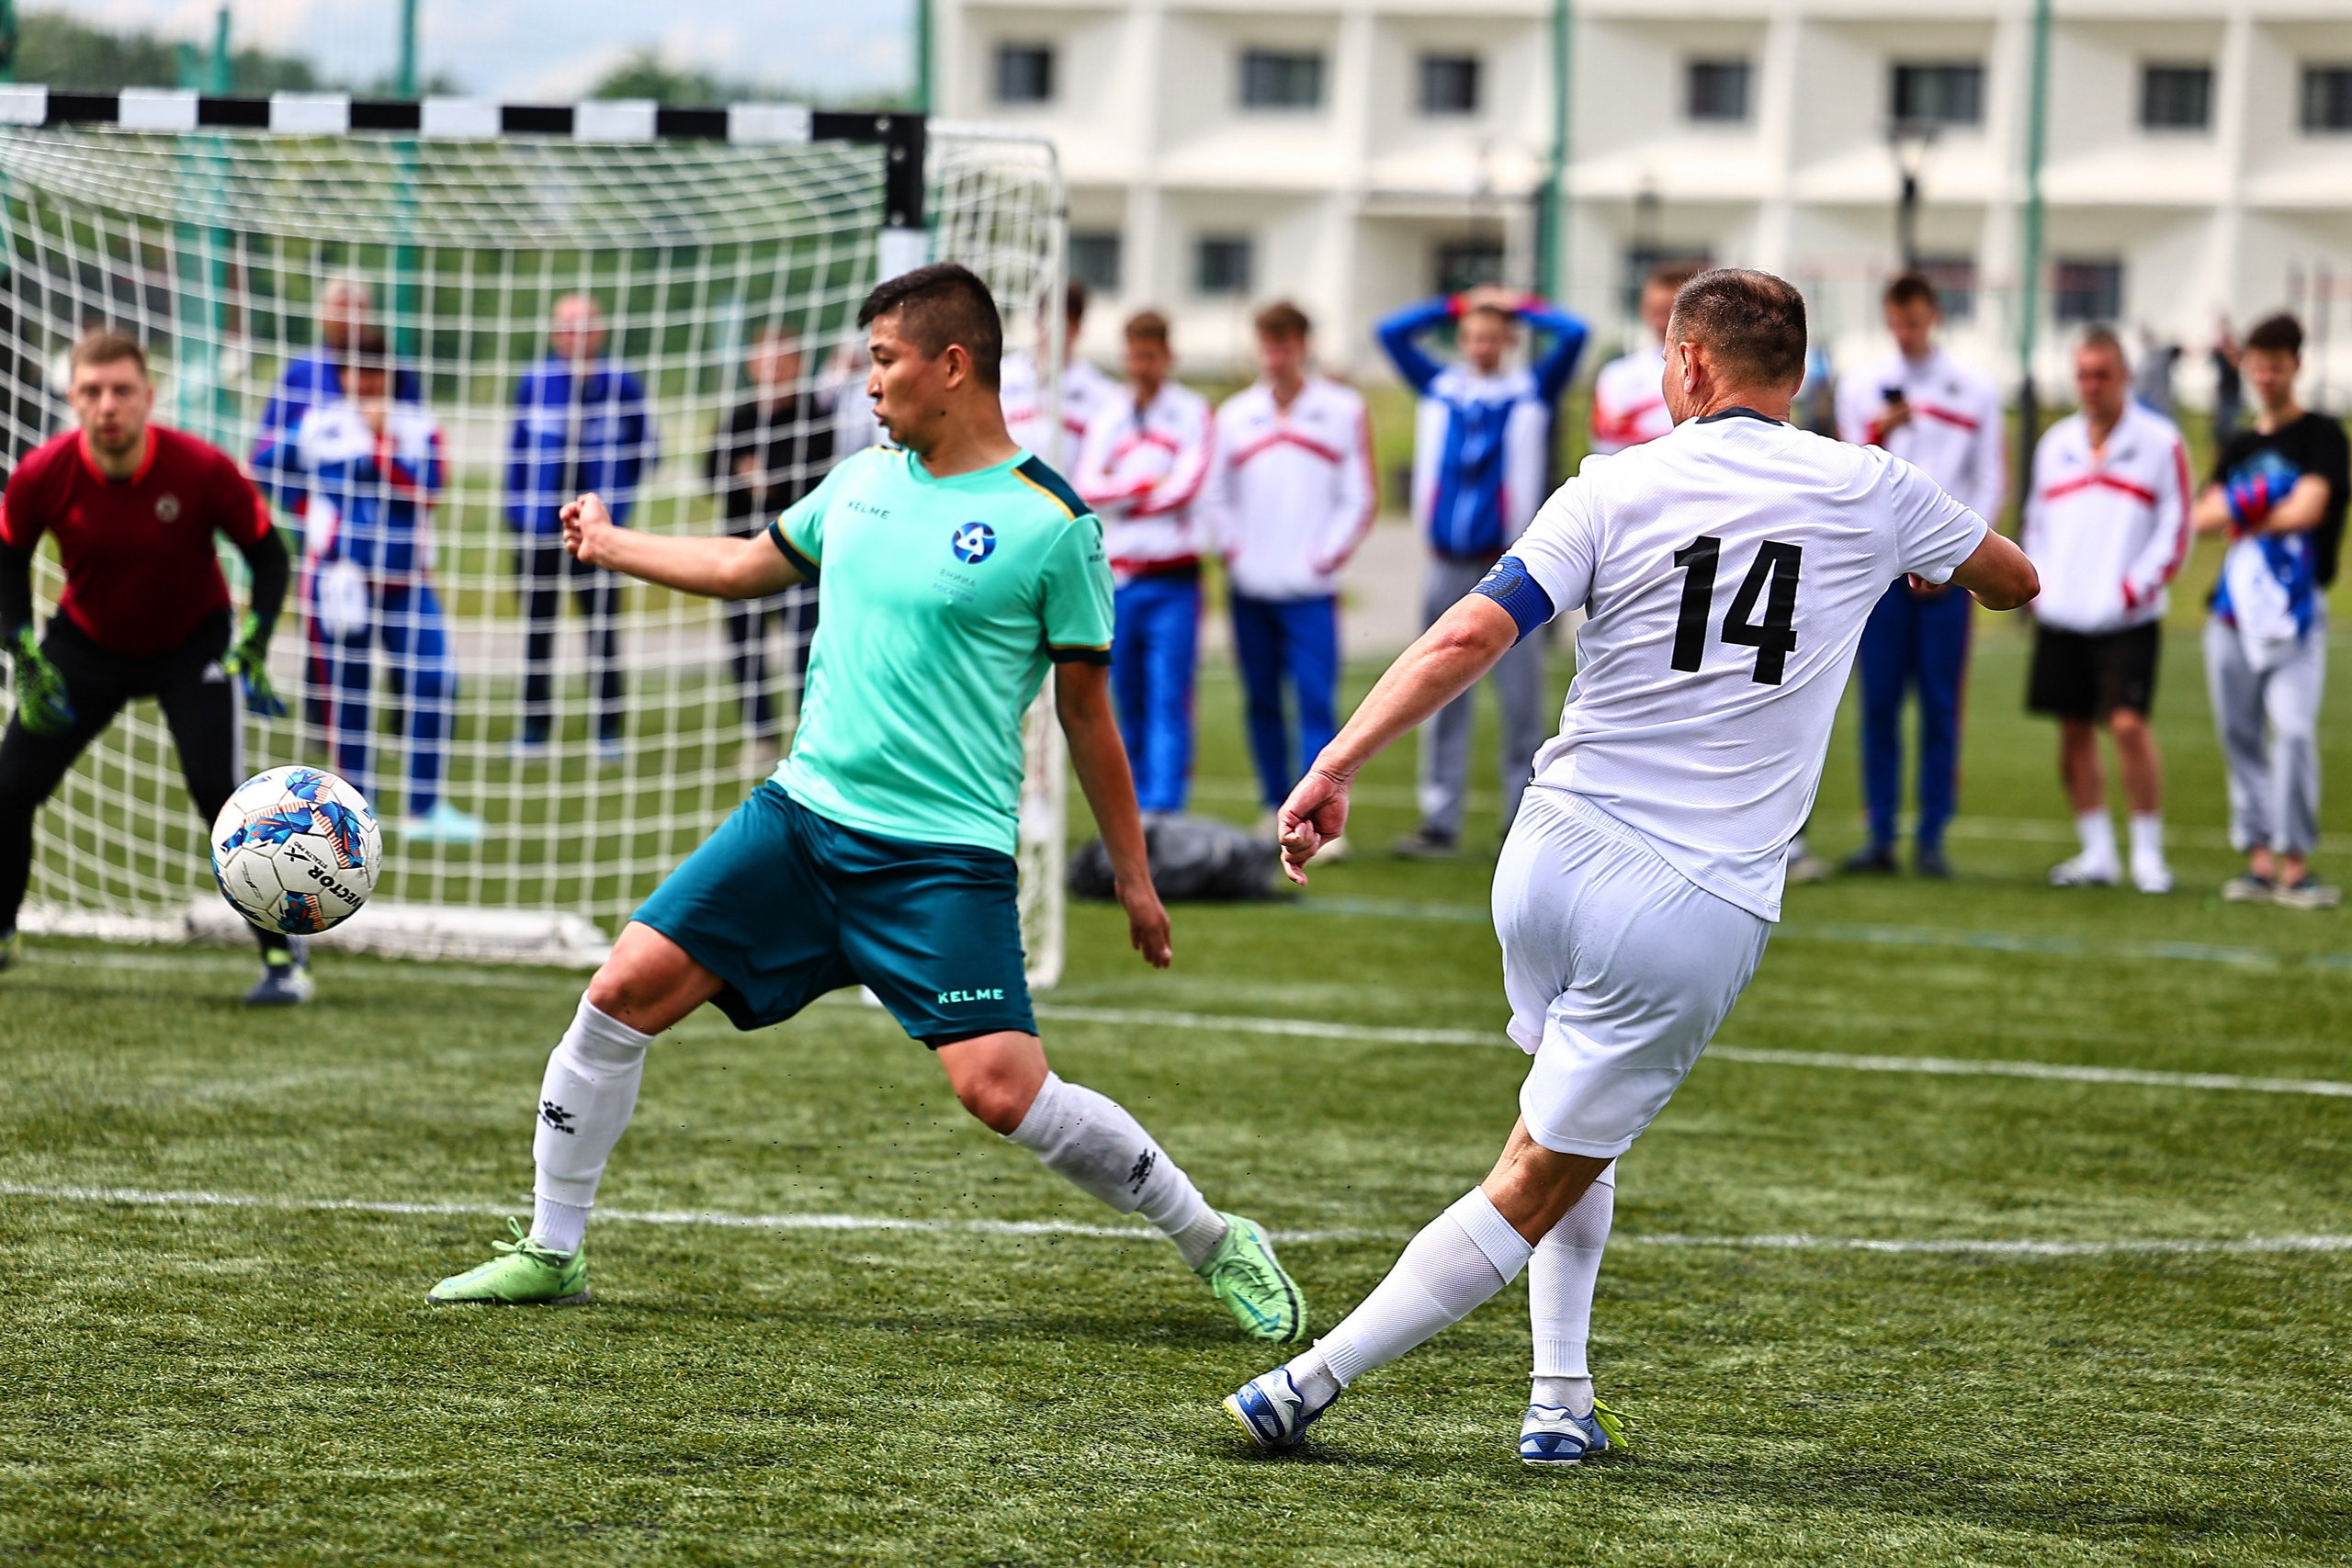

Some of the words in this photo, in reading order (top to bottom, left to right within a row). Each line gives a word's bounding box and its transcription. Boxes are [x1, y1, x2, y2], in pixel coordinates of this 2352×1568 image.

[846, 501, 891, 519] KELME
[1670, 535, 1803, 686] 14
[293, 840, 306, 853] PRO
[304, 850, 328, 869] STEALTH
[308, 865, 362, 908] VECTOR
[937, 987, 1005, 1005] KELME
